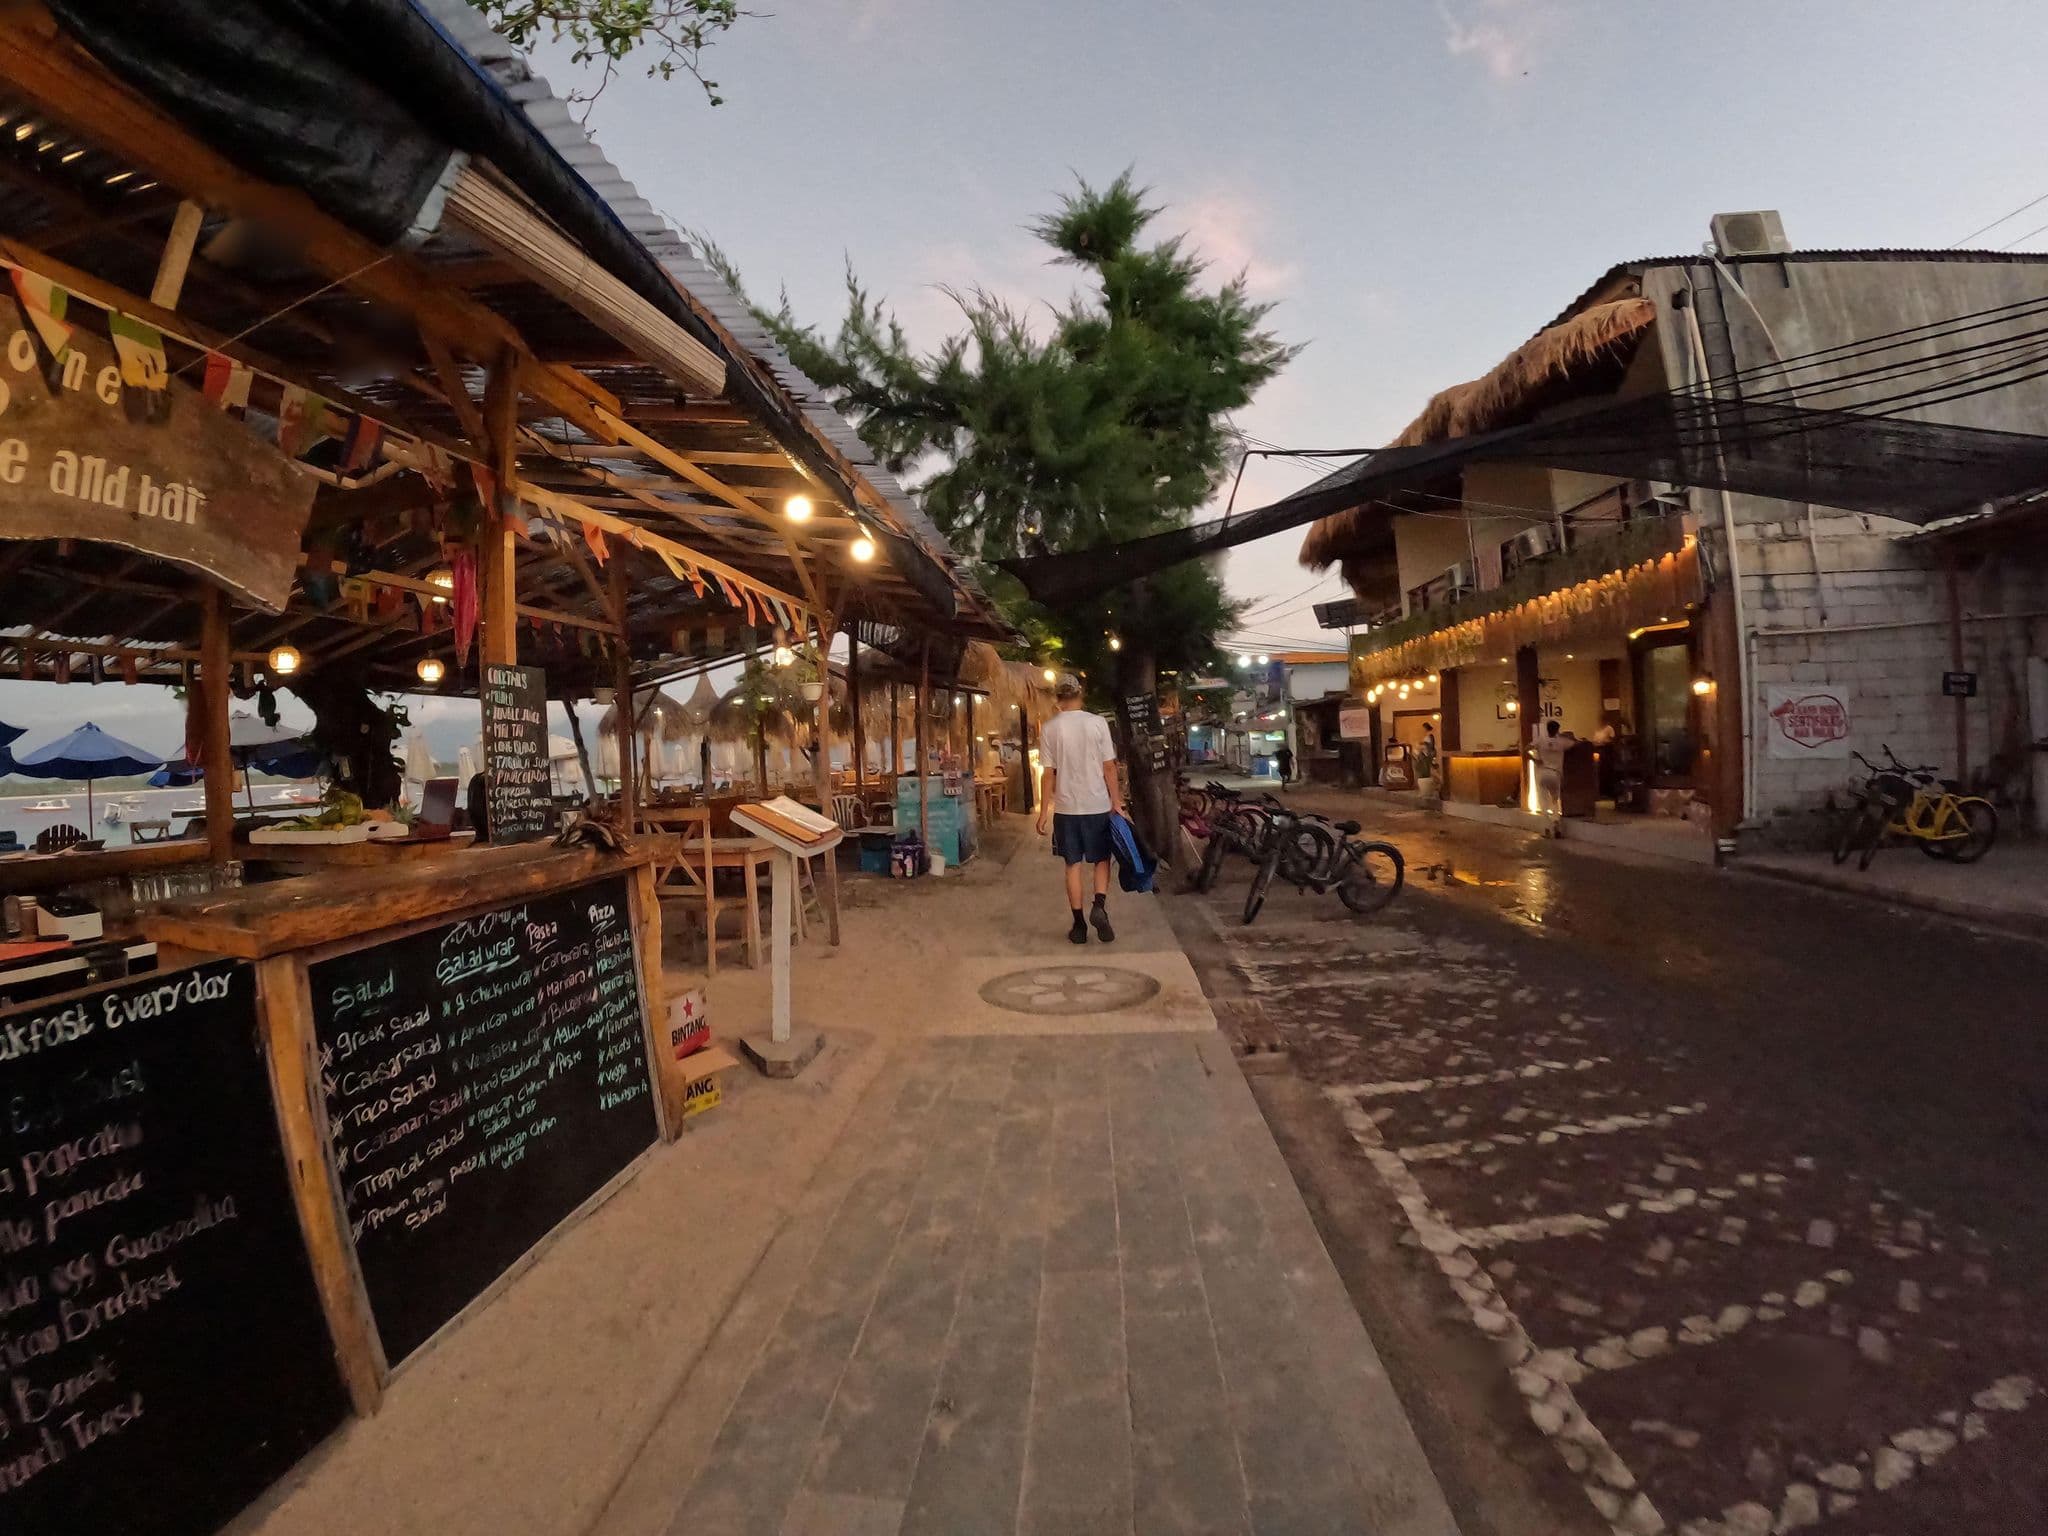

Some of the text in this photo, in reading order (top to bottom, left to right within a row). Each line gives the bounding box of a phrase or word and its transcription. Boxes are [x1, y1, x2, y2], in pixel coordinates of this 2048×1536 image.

[50, 449, 130, 508] and
[138, 474, 208, 525] bar
[1496, 703, 1516, 720] La
[671, 1015, 707, 1047] BINTANG
